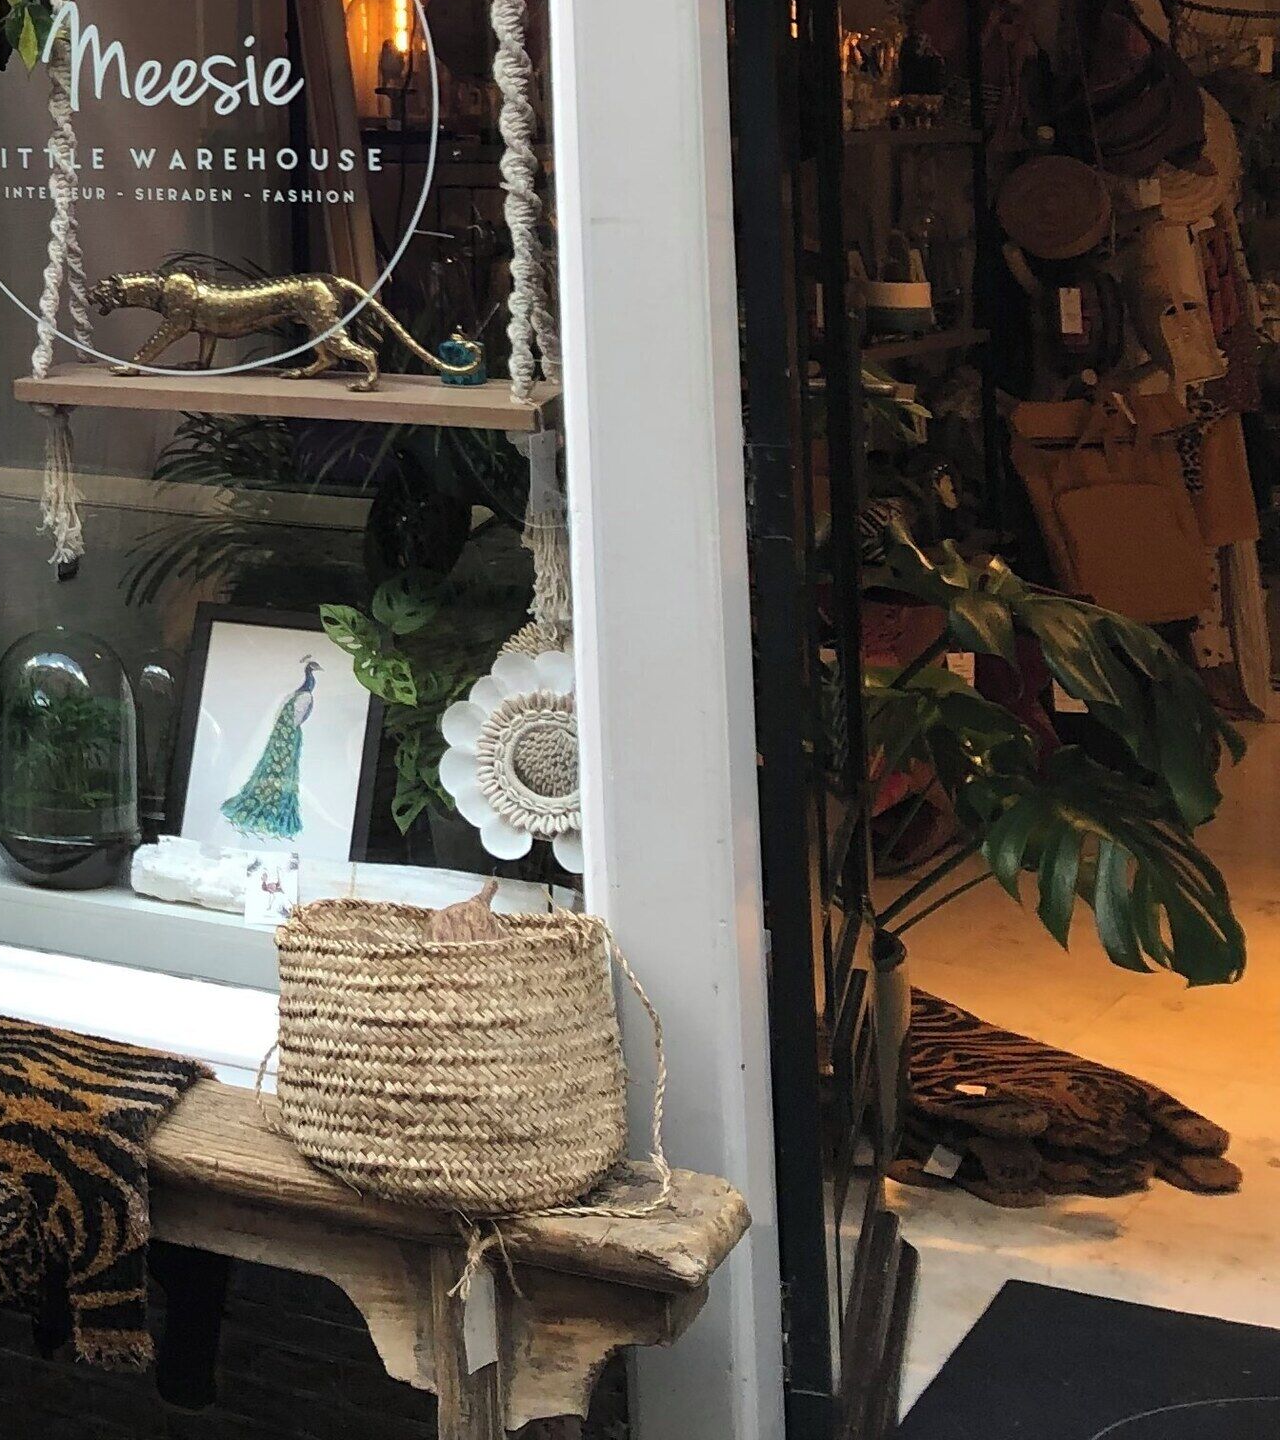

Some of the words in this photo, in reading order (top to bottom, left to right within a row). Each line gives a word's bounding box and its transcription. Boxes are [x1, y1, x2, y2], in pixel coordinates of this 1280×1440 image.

[42, 1, 305, 116] Meesie
[129, 148, 383, 172] WAREHOUSE
[135, 187, 233, 202] SIERADEN
[262, 188, 356, 204] FASHION
